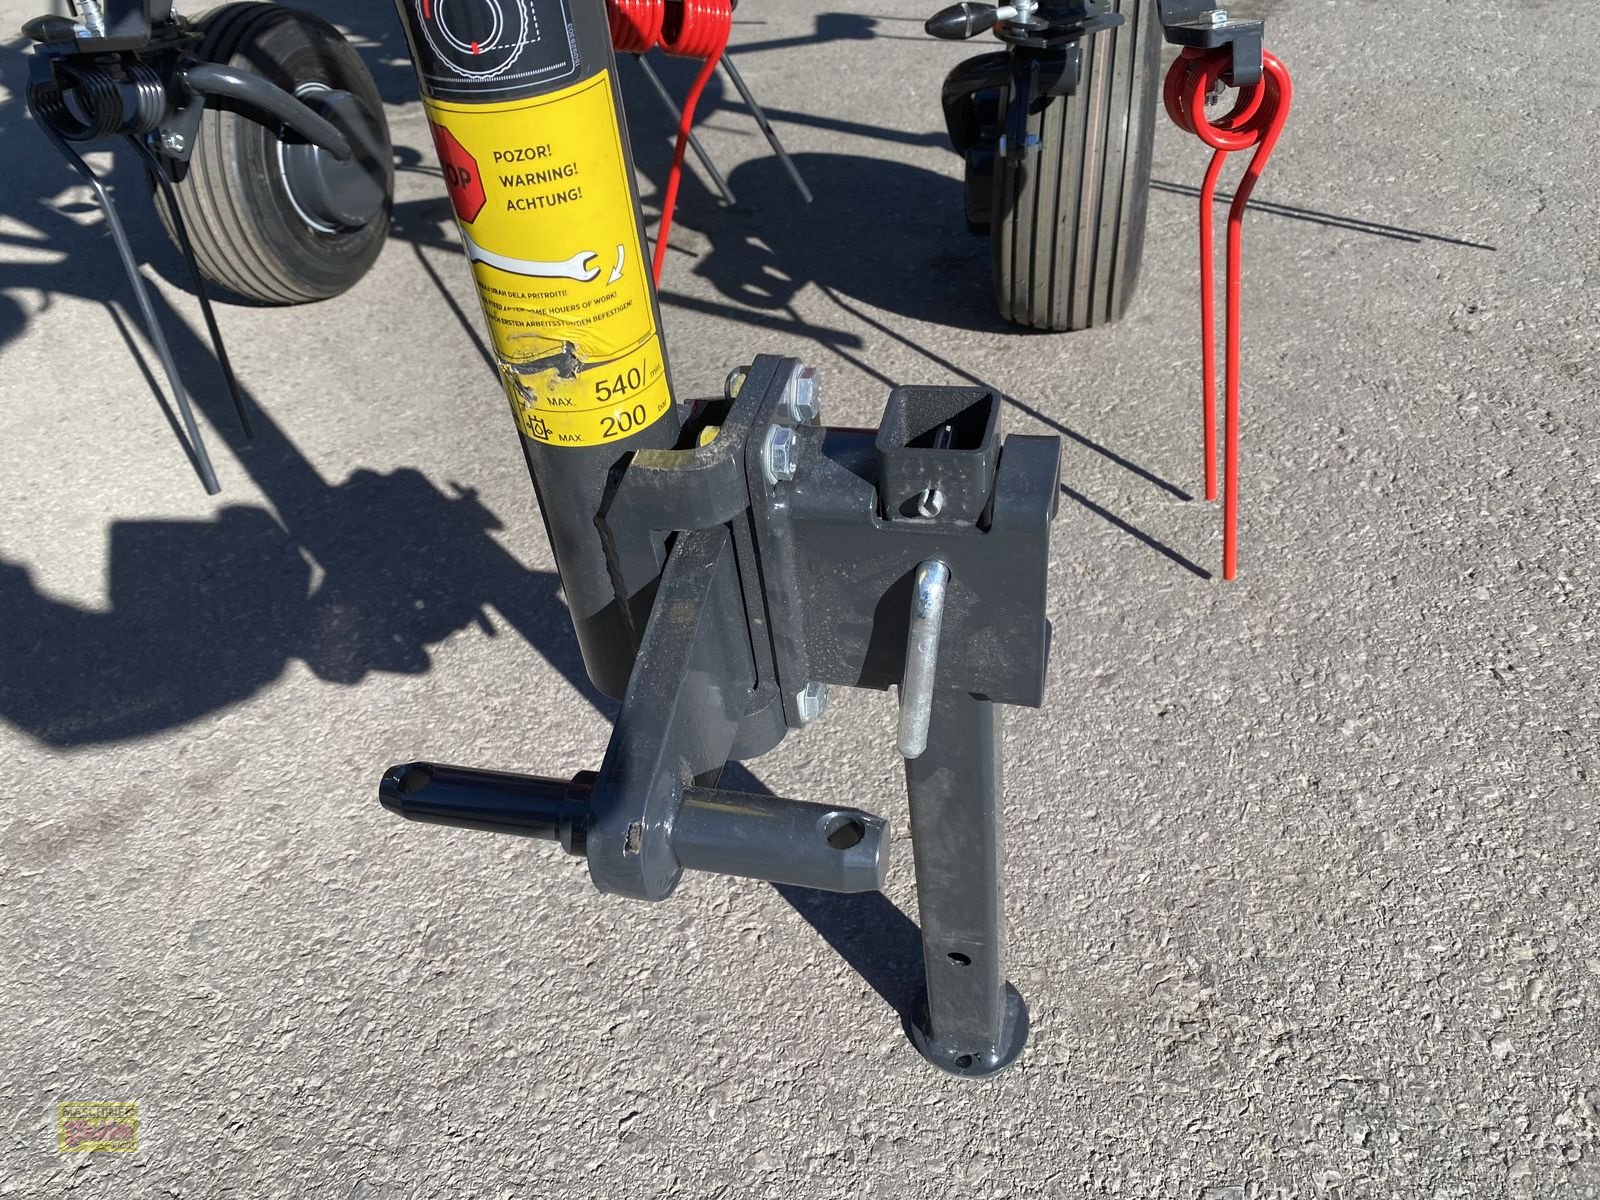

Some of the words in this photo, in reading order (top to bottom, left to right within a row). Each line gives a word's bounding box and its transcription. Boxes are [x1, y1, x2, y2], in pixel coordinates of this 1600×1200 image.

[493, 144, 552, 163] POZOR!
[445, 163, 472, 190] OP
[499, 162, 579, 188] WARNING!
[506, 186, 583, 211] ACHTUNG!
[507, 289, 527, 299] DELA
[527, 290, 568, 299] PRITRDITI!
[548, 303, 581, 314] HOUERS
[581, 300, 592, 309] OF
[593, 291, 618, 304] WORK!
[592, 299, 633, 322] BEFESTIGEN!
[546, 397, 576, 407] MAX.
[558, 434, 585, 442] MAX.
[600, 404, 647, 439] 200
[657, 399, 667, 412] bar
